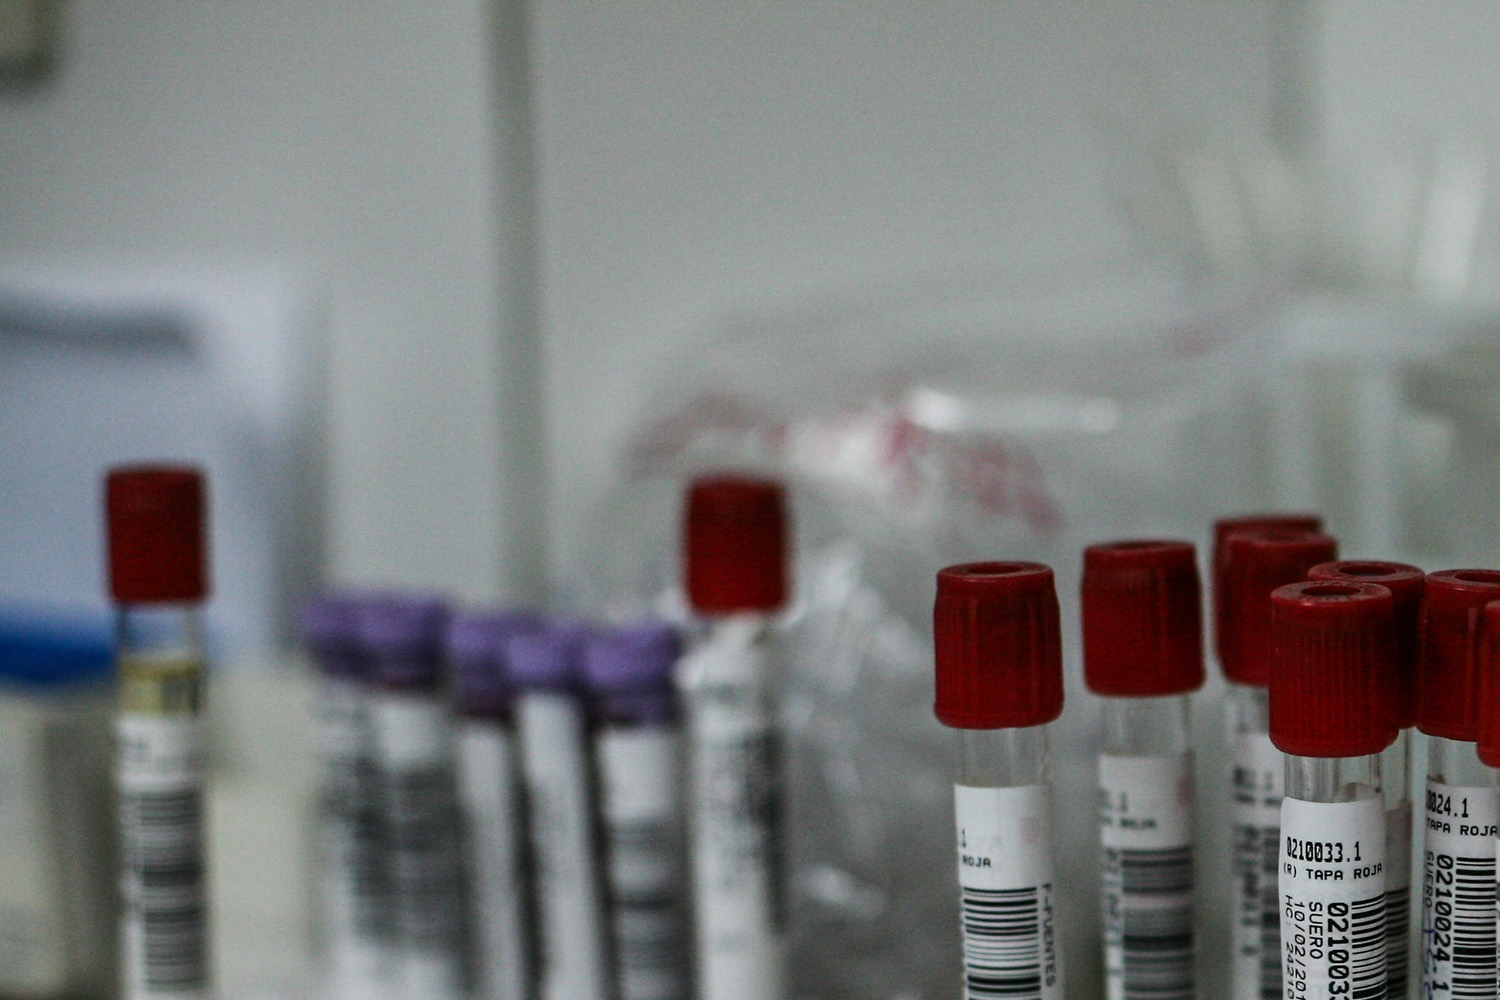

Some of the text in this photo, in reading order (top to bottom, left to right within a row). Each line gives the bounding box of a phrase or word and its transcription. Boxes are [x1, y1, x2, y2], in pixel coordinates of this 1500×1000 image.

[1427, 817, 1498, 837] TAPA ROJA
[962, 855, 992, 868] ROJA
[1286, 836, 1361, 863] 0210033.1
[1283, 862, 1383, 881] (R) TAPA ROJA
[1424, 850, 1434, 908] SUERO
[1309, 901, 1324, 960] SUERO
[1432, 854, 1454, 991] 0210024.1
